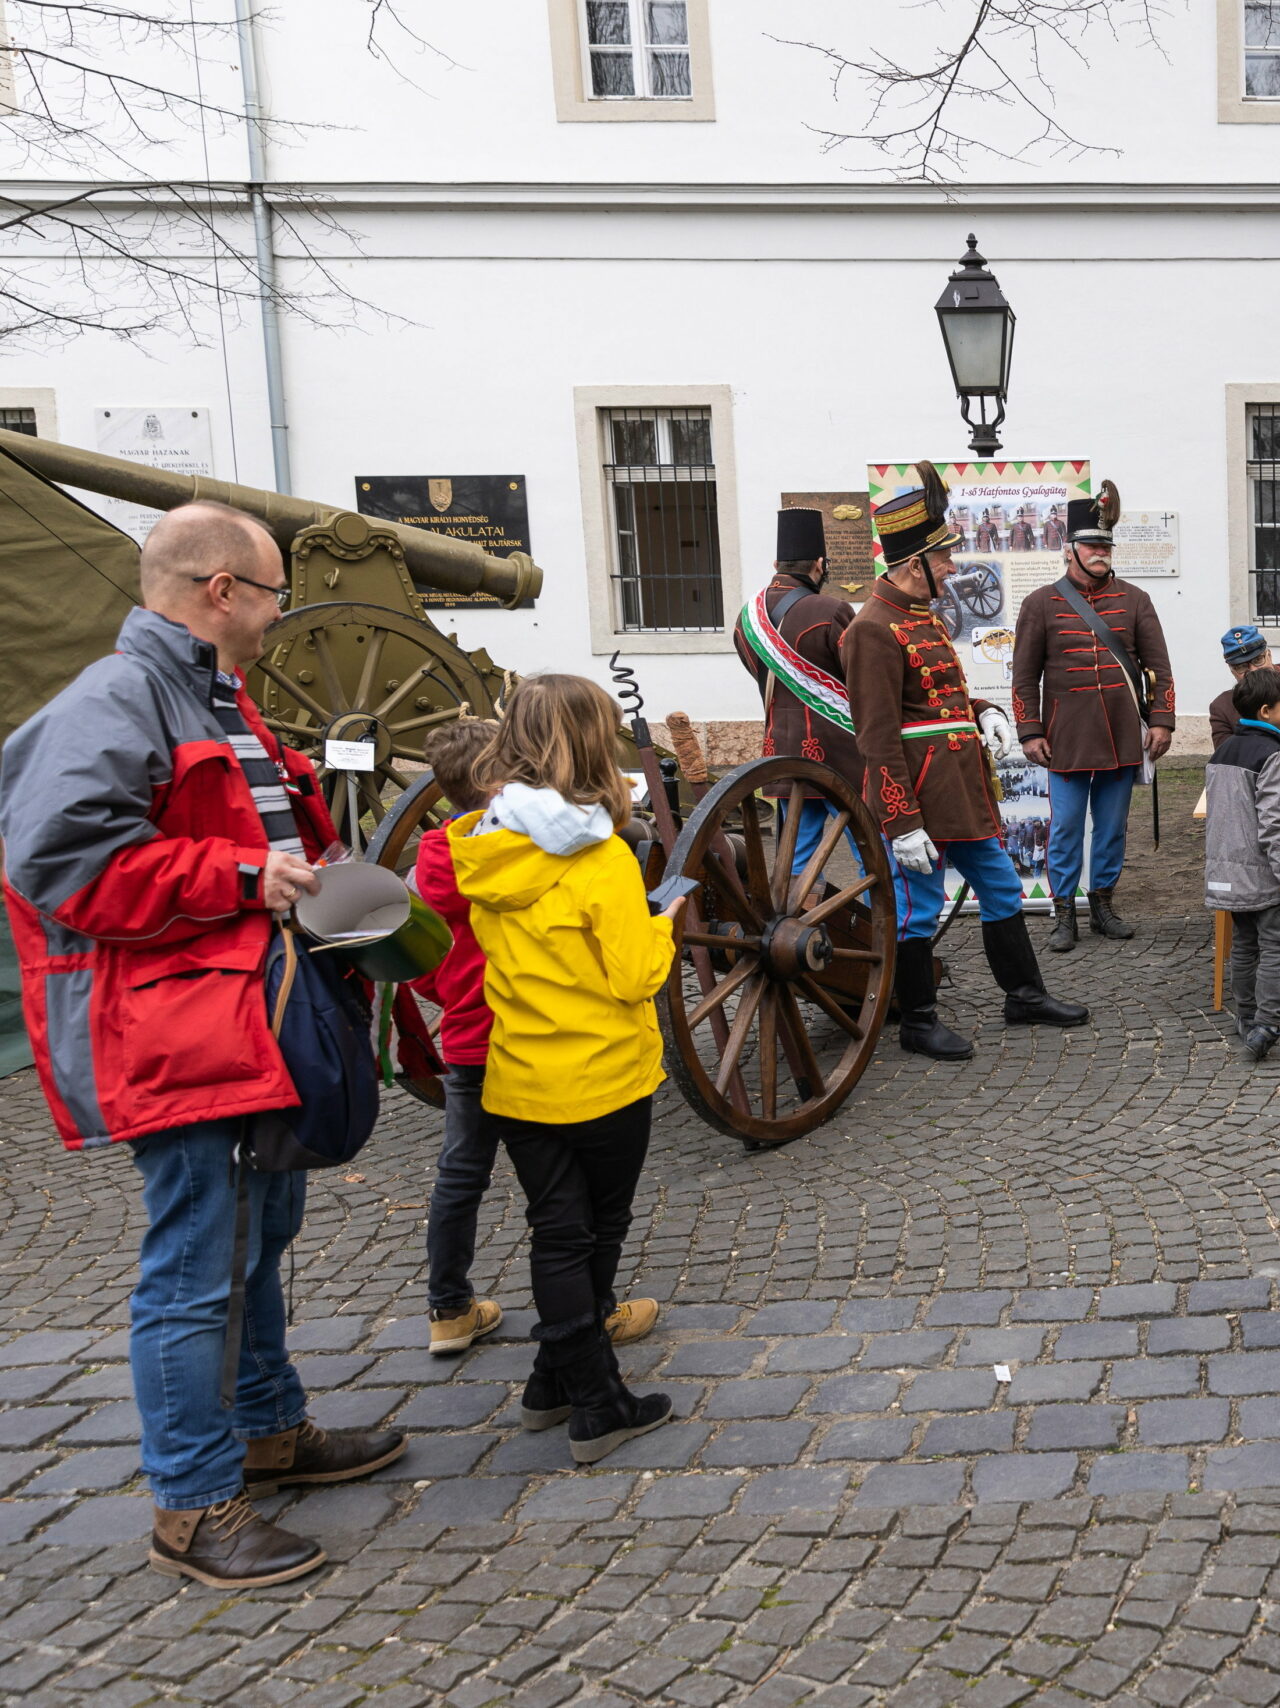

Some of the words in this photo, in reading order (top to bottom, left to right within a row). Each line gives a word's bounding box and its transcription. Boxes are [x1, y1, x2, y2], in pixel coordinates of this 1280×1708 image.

[978, 486, 1020, 498] Hatfontos
[404, 516, 429, 524] MAGYAR
[430, 515, 452, 524] KIRÁLYI
[453, 514, 489, 523] HONVÉDSÉG
[488, 538, 522, 547] BAJTÁRSAK
